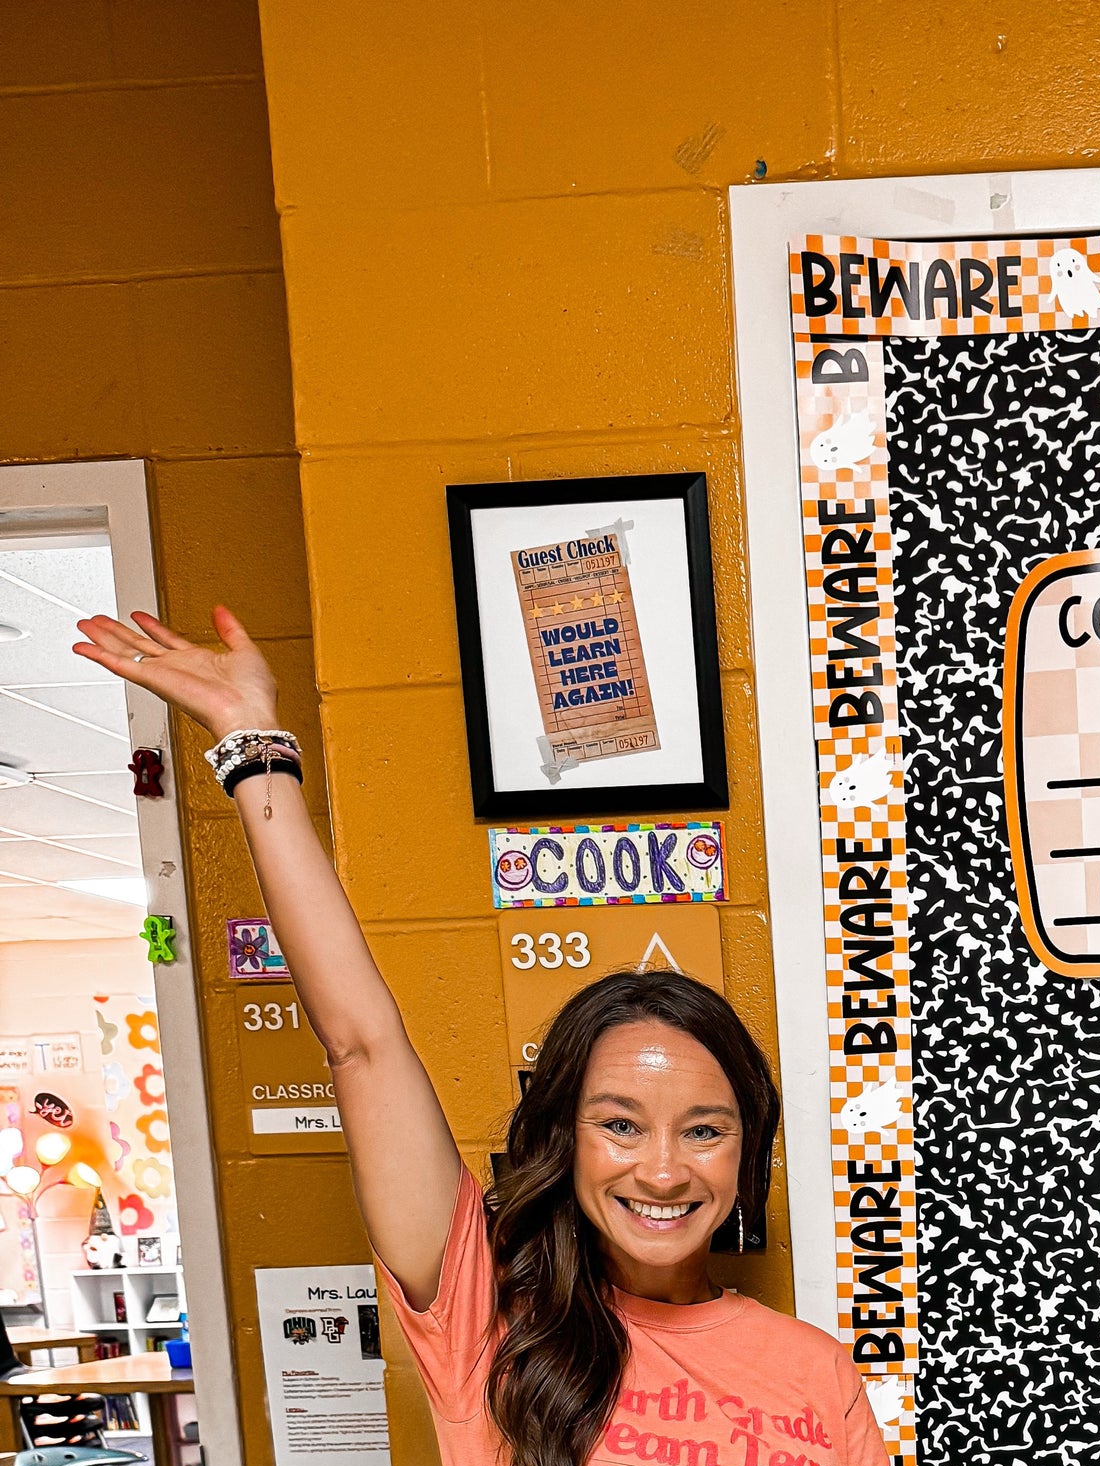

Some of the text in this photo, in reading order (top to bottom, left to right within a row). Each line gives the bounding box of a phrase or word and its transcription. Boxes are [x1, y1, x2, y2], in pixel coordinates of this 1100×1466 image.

[801, 250, 1021, 320] BEWARE
[811, 334, 869, 384] B
[518, 545, 563, 568] Guest
[567, 535, 616, 559] Check
[585, 556, 615, 570] 051197
[818, 498, 885, 729] BEWARE
[541, 618, 619, 646] WOULD
[548, 638, 621, 667] LEARN
[560, 661, 618, 686] HERE
[554, 679, 634, 709] AGAIN!
[530, 831, 685, 893] COOK
[511, 932, 590, 970] 333
[836, 837, 897, 1055] BEWARE
[243, 1002, 299, 1031] 331
[295, 1116, 328, 1129] Mrs.
[848, 1160, 905, 1364] BEWARE
[308, 1287, 342, 1300] Mrs.
